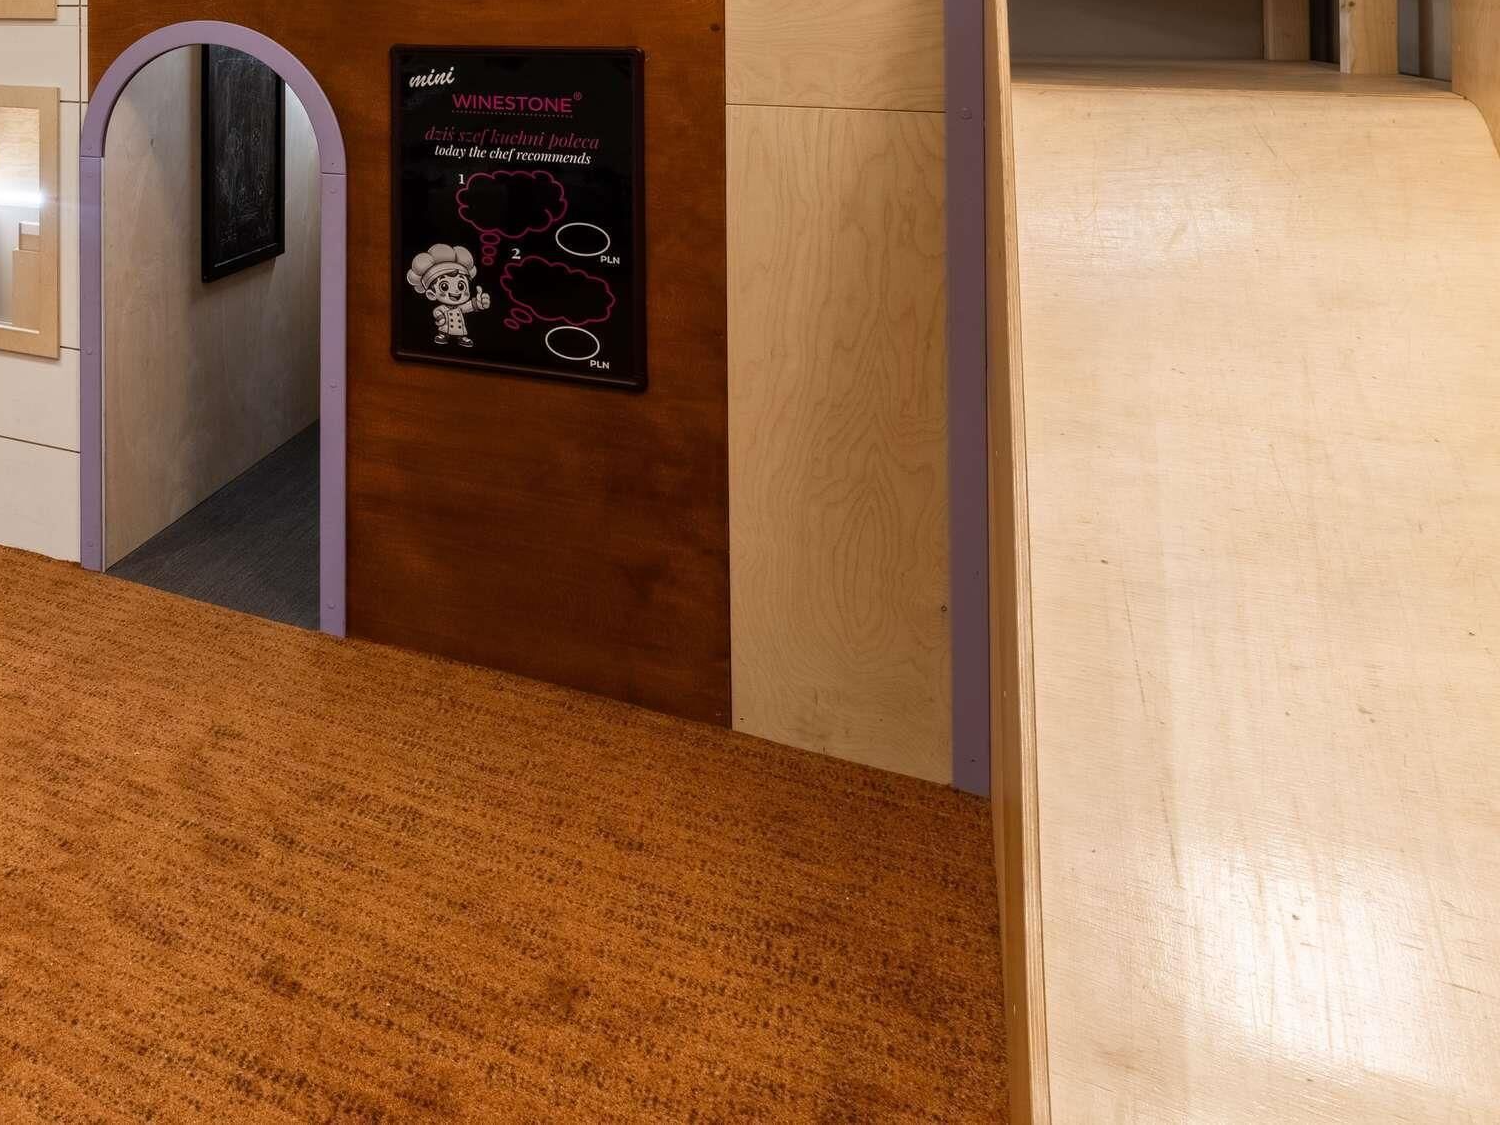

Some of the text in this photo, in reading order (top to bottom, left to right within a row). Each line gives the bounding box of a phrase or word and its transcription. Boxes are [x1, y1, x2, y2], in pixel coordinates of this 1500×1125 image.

[409, 66, 455, 88] mini
[489, 129, 545, 148] kuchni
[546, 132, 601, 150] poleca
[434, 144, 592, 165] today the chef recommends
[458, 174, 466, 185] 1
[511, 248, 522, 260] 2
[600, 255, 621, 265] PLN
[589, 359, 610, 370] PLN
